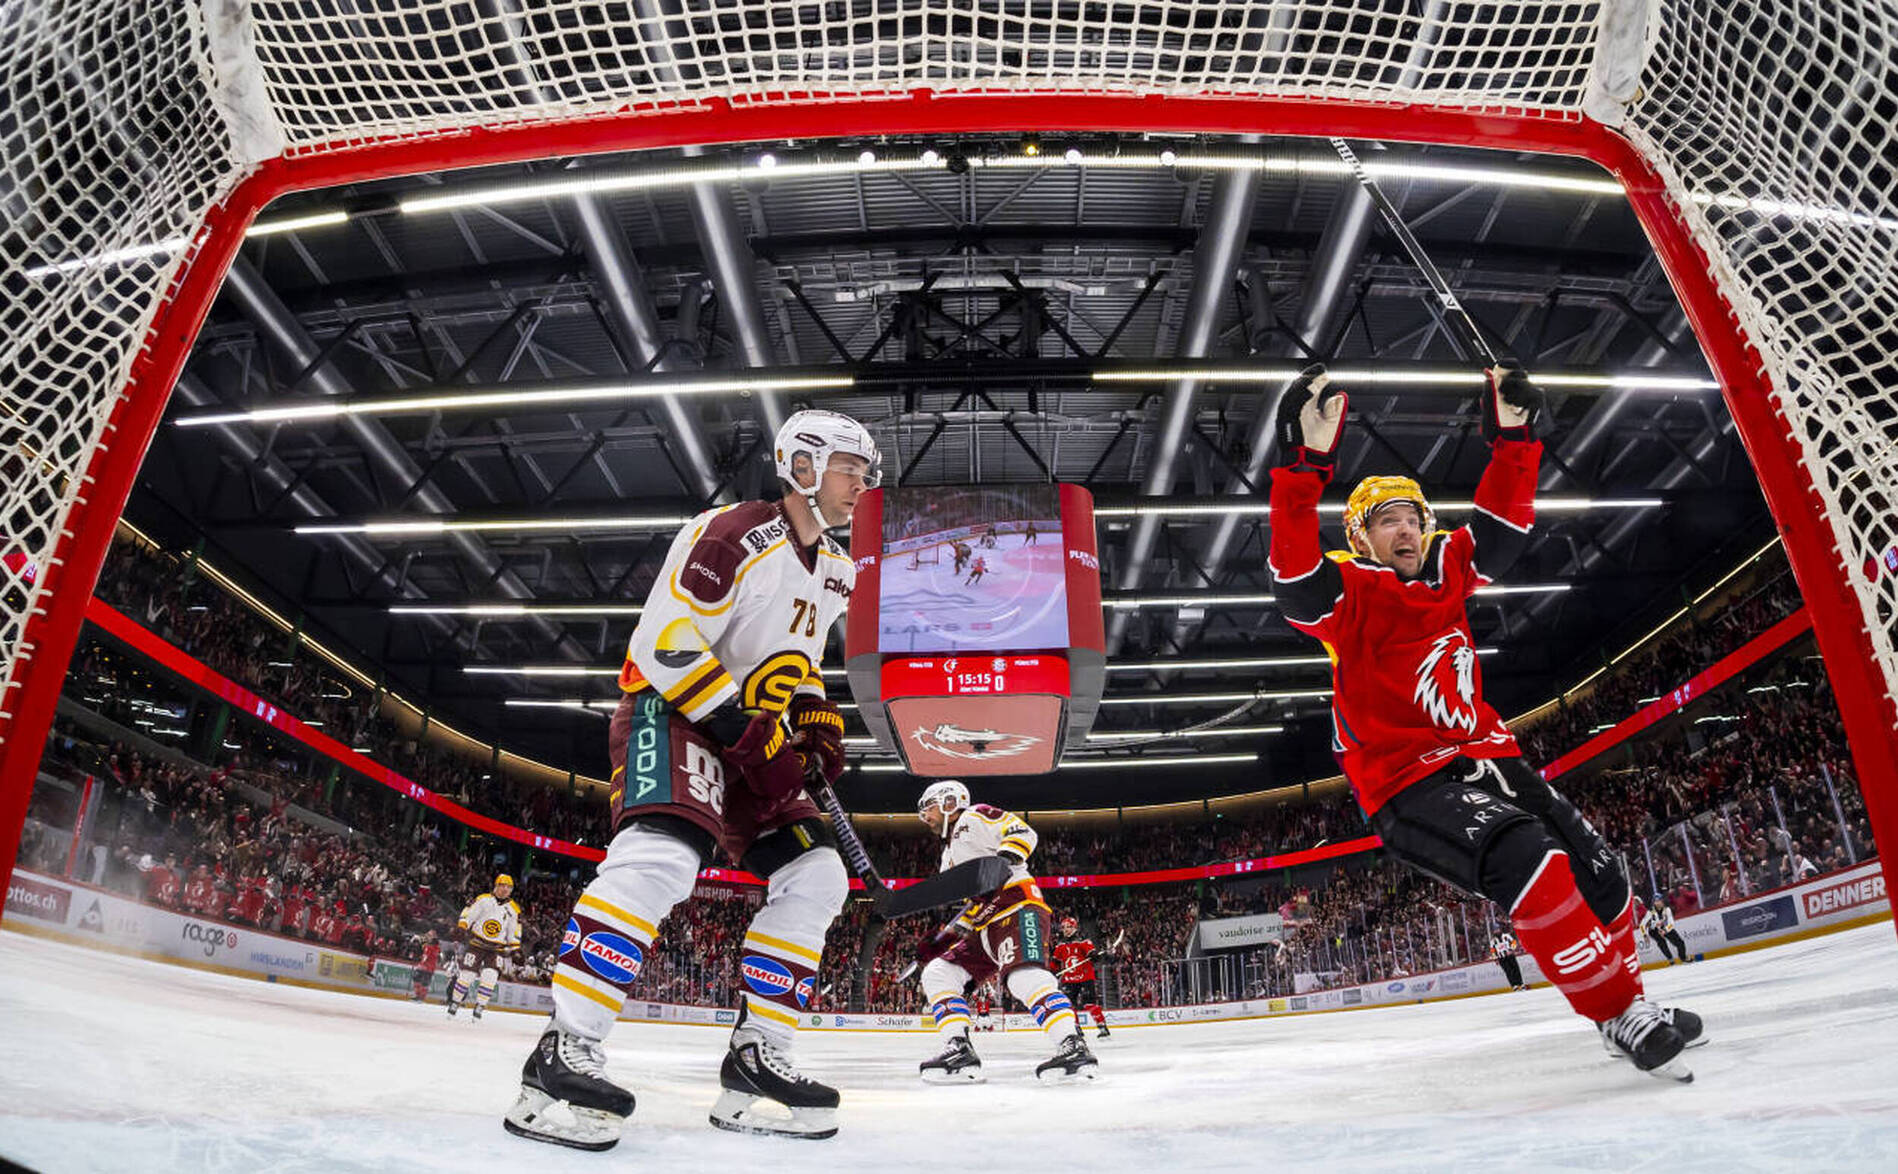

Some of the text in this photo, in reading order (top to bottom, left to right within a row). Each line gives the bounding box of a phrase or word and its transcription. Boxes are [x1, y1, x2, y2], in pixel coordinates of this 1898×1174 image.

[789, 597, 817, 637] 78
[947, 676, 953, 693] 1
[957, 672, 991, 686] 15:15
[995, 675, 1004, 692] 0
[1809, 876, 1887, 915] DENNER
[182, 923, 225, 957] rouge
